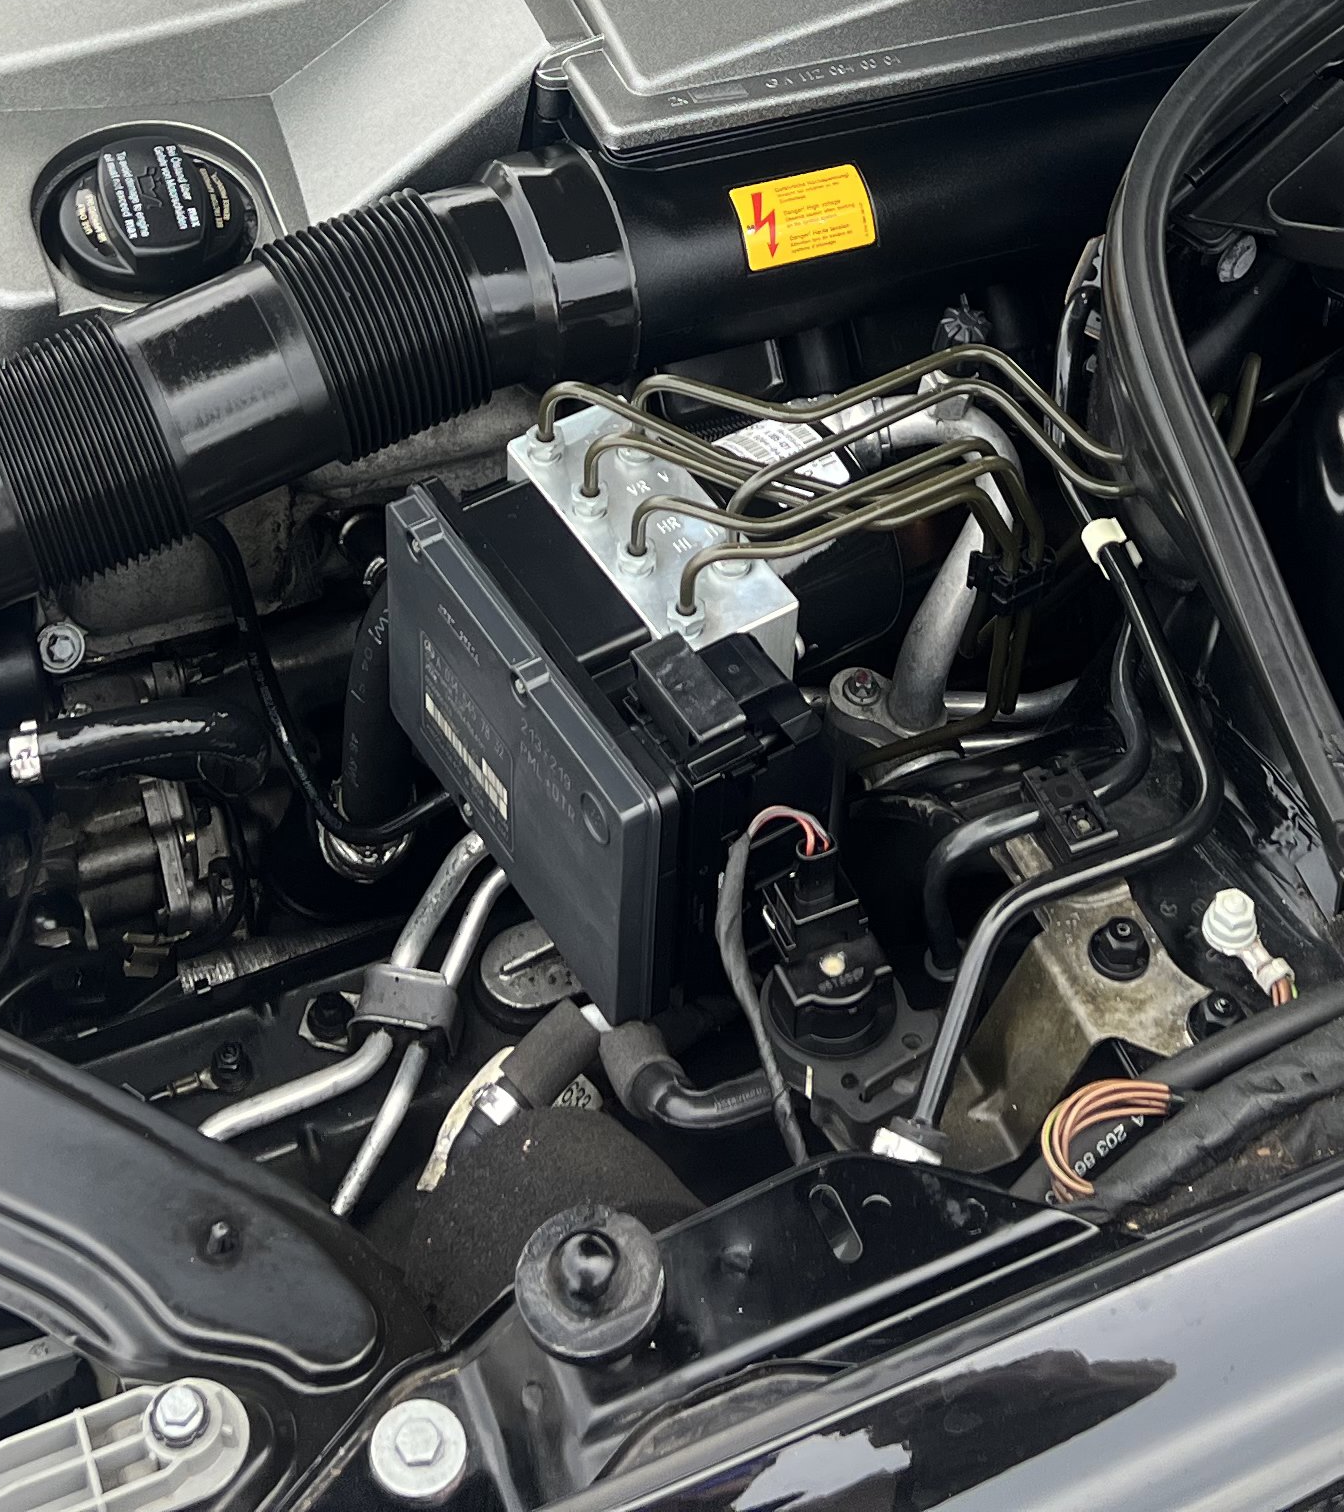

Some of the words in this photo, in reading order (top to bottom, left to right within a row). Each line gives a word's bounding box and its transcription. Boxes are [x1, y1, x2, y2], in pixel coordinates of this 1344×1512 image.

[118, 160, 133, 178] avoid
[124, 177, 140, 204] damage
[116, 190, 133, 218] exceed
[135, 211, 150, 238] engine
[187, 207, 201, 228] max
[124, 218, 138, 239] max
[626, 480, 651, 496] VR
[657, 516, 681, 534] HR
[1096, 1123, 1127, 1157] 203
